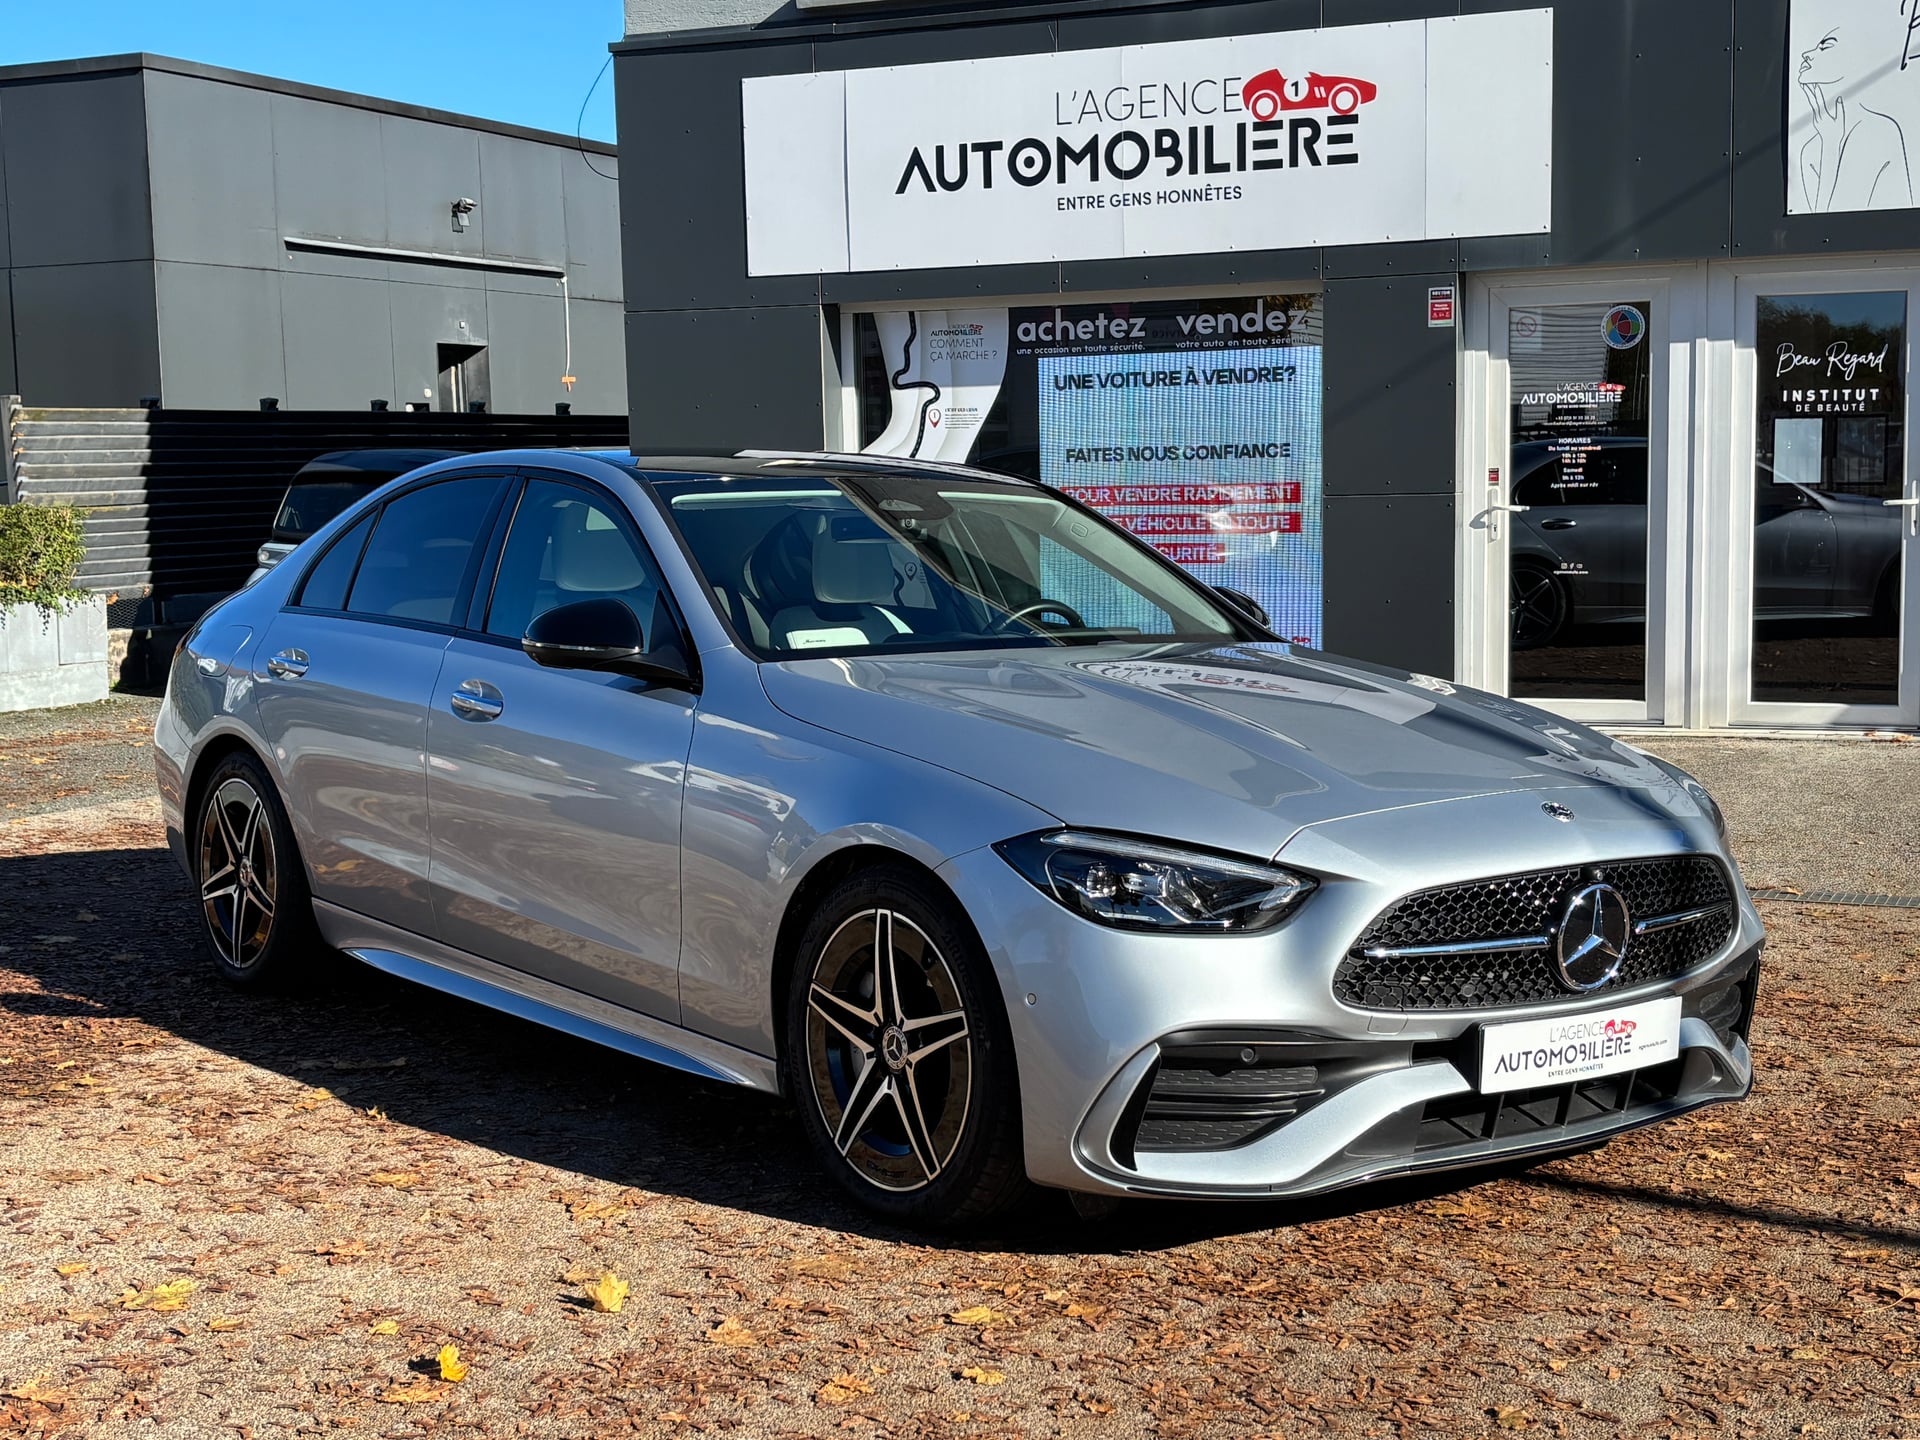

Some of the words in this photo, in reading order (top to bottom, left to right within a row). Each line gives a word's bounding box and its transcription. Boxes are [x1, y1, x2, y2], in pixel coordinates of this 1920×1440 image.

[1055, 77, 1243, 126] L'AGENCE
[1057, 194, 1105, 211] ENTRE
[1109, 191, 1151, 208] GENS
[1156, 183, 1242, 205] HONNÊTES
[1016, 308, 1146, 342] achetez
[1176, 299, 1308, 335] vendez
[929, 337, 985, 349] COMMENT
[1034, 345, 1069, 354] occasion
[1085, 344, 1108, 352] toute
[1176, 340, 1200, 349] votre
[1203, 339, 1225, 348] auto
[1242, 338, 1268, 346] toute
[930, 351, 944, 363] ÇA
[945, 350, 990, 361] MARCHE
[992, 350, 998, 360] ?
[1776, 342, 1822, 378] Beau
[1825, 341, 1889, 381] Regard
[1054, 373, 1093, 391] UNE
[1097, 370, 1182, 389] VOITURE
[1184, 366, 1199, 386] À
[1201, 365, 1297, 386] VENDRE?
[1782, 388, 1880, 402] INSTITUT
[1795, 403, 1811, 412] DE
[1817, 401, 1866, 412] BEAUTÉ
[1066, 447, 1125, 463] FAITES
[1127, 445, 1180, 462] NOUS
[1182, 442, 1291, 461] CONFIANCE
[1114, 487, 1182, 503] VENDRE
[1183, 484, 1294, 502] RAPIDEMENT
[1126, 514, 1207, 531] VÉHICULE
[1235, 514, 1290, 530] TOUTE
[1549, 1020, 1605, 1043] L'AGENCE
